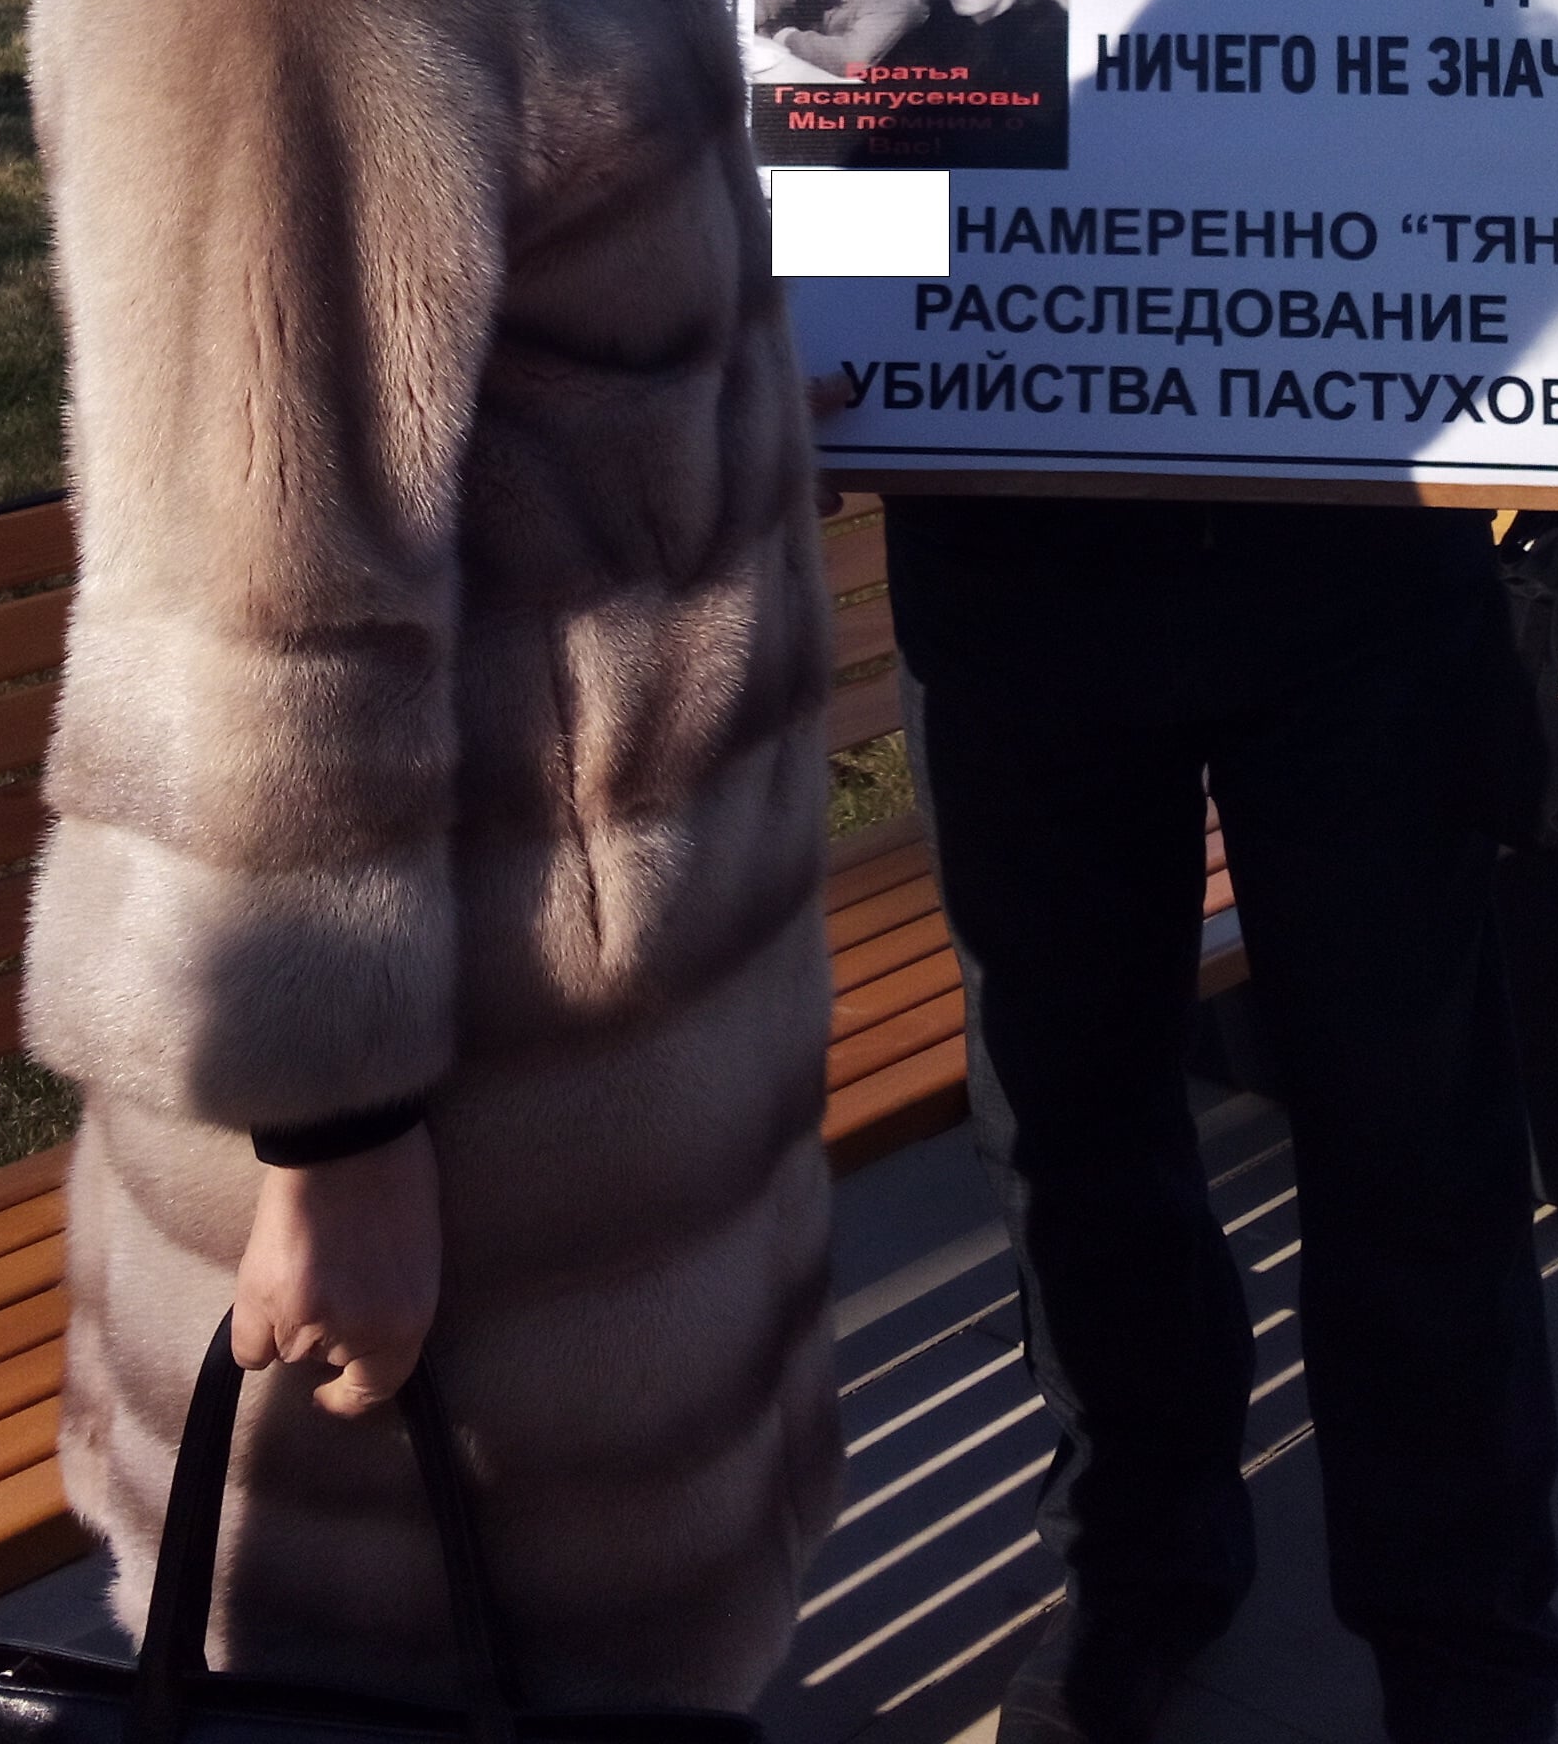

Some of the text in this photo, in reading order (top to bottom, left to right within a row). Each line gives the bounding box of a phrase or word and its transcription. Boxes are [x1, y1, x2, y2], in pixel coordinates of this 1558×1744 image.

[845, 61, 970, 84] Братья
[1095, 33, 1317, 97] НИЧЕГО
[1337, 36, 1408, 95] НЕ
[774, 85, 1041, 109] Гасангусеновы
[788, 111, 846, 131] Мы
[855, 114, 993, 131] помним
[956, 206, 1378, 258] НАМЕРЕННО
[915, 282, 1508, 346] РАССЛЕДОВАНИЕ
[841, 349, 1196, 418] УБИЙСТВА
